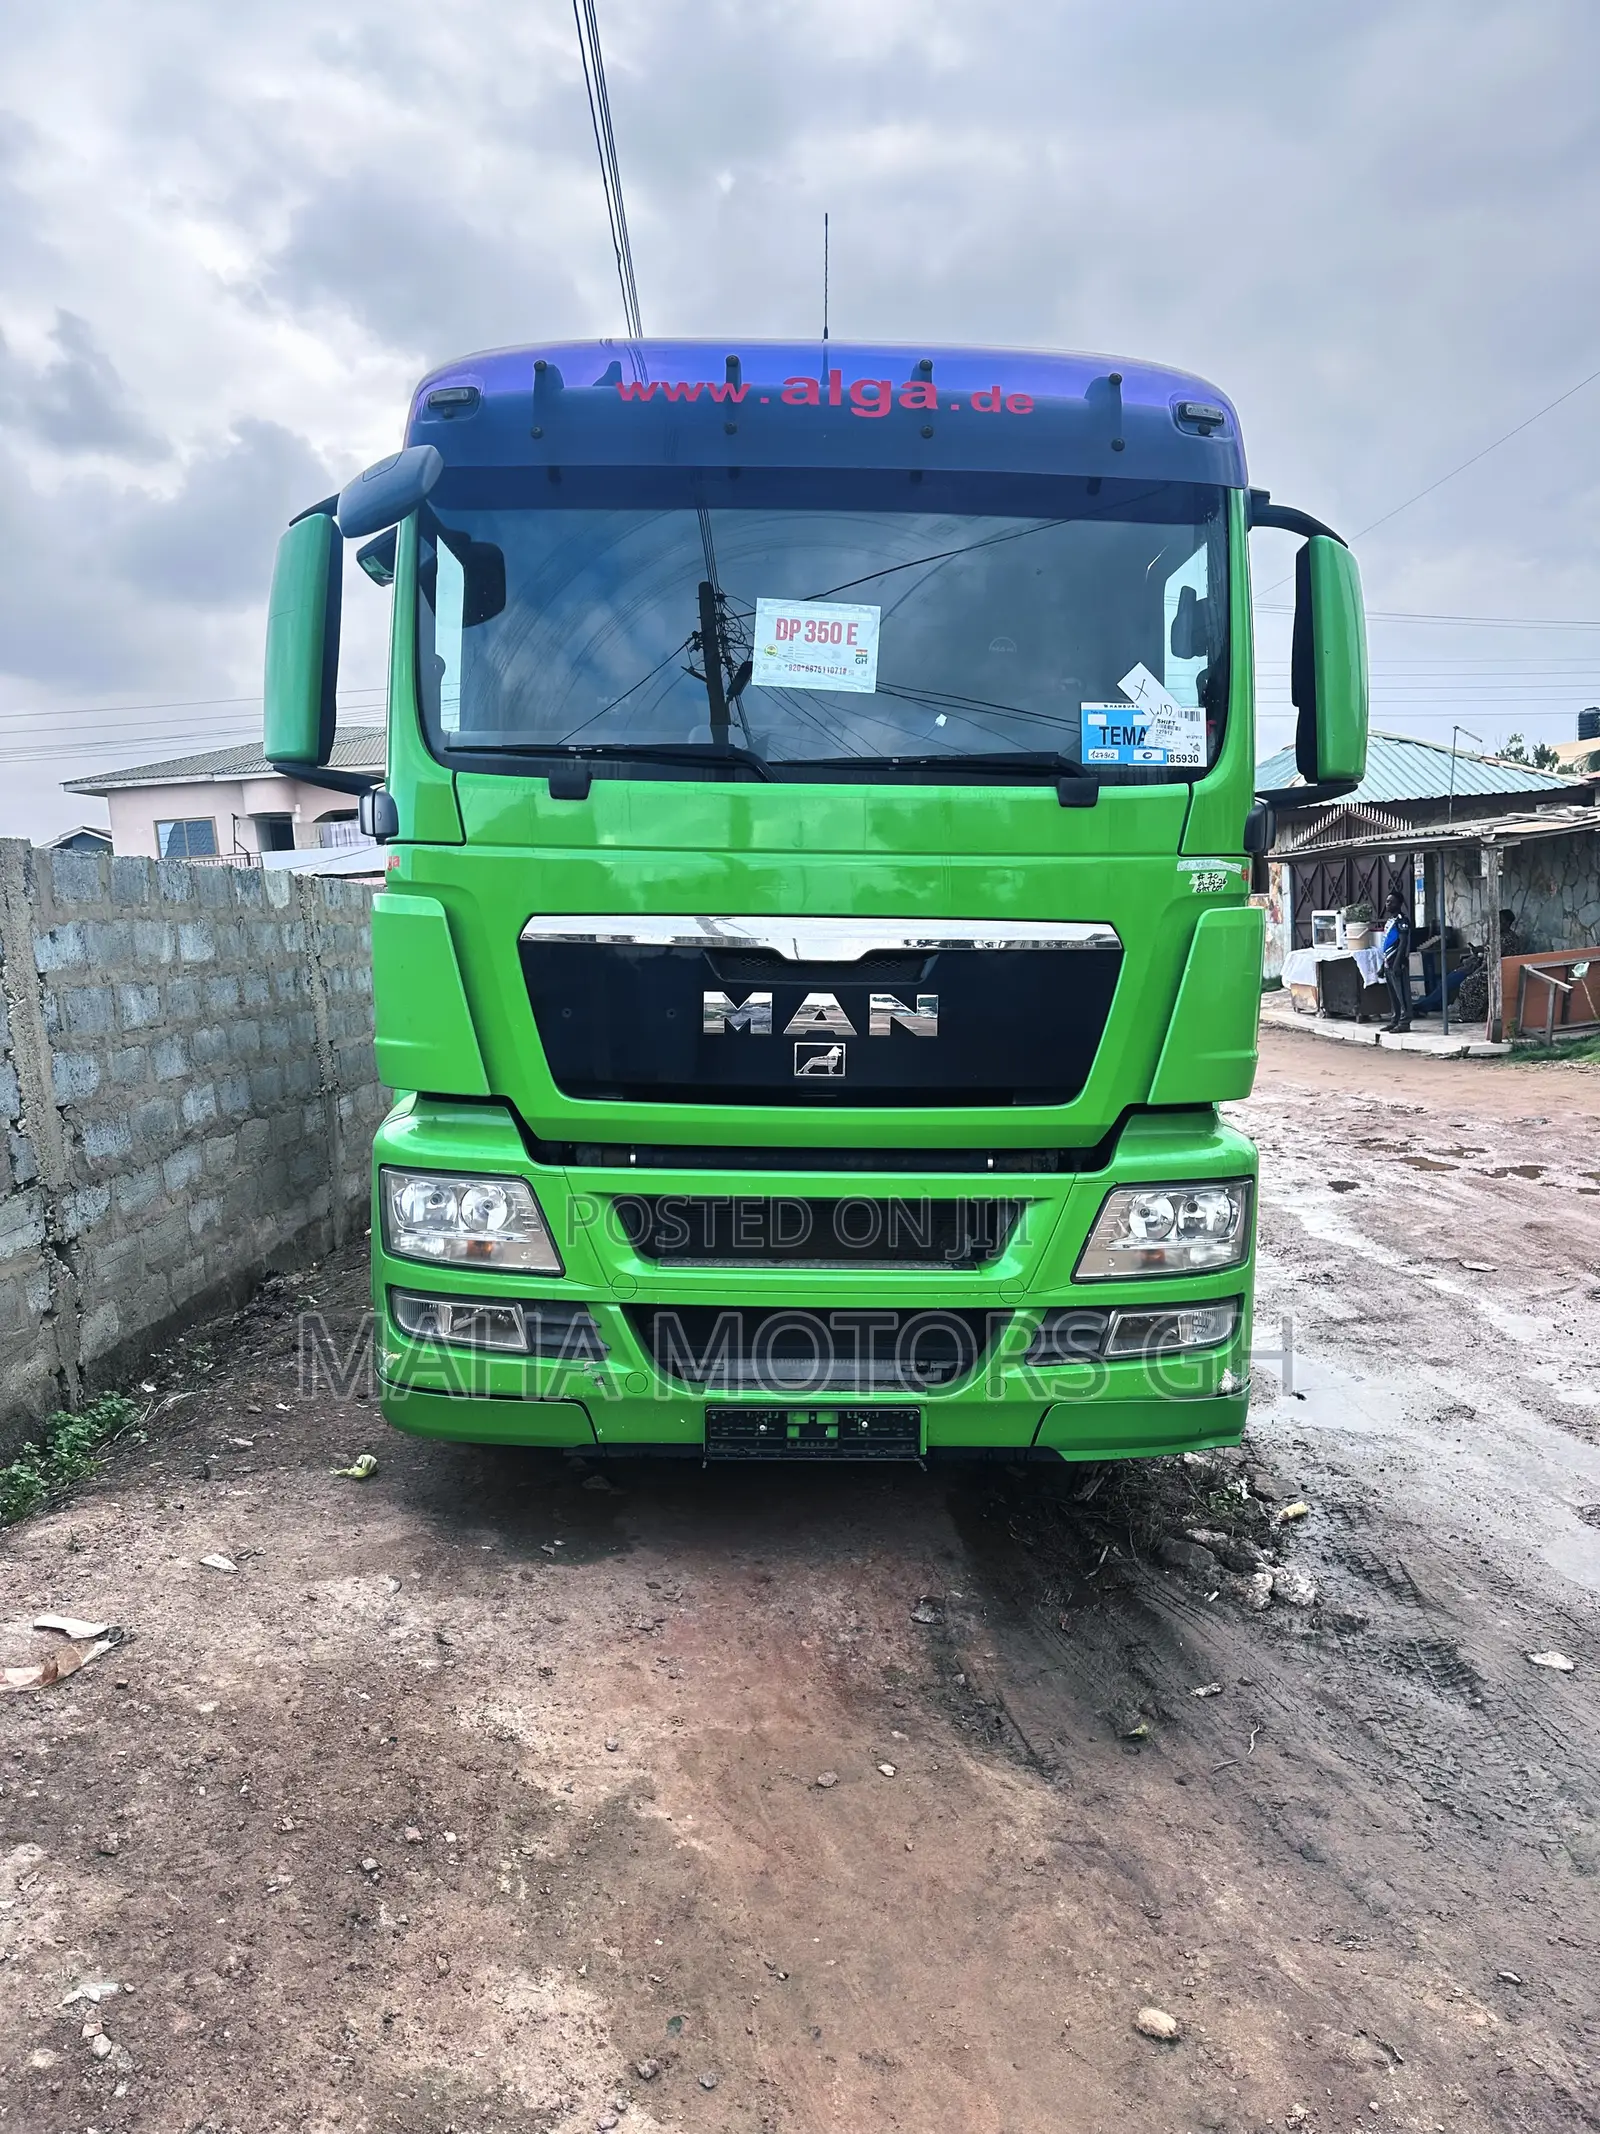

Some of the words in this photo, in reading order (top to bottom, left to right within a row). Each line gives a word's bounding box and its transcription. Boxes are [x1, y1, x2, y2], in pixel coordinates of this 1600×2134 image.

[616, 369, 1035, 418] www.alga.de
[775, 617, 802, 641] DP
[804, 619, 843, 644] 350
[846, 622, 859, 646] E
[854, 657, 868, 665] GH
[1098, 726, 1147, 746] TEMA
[703, 991, 939, 1037] MAN
